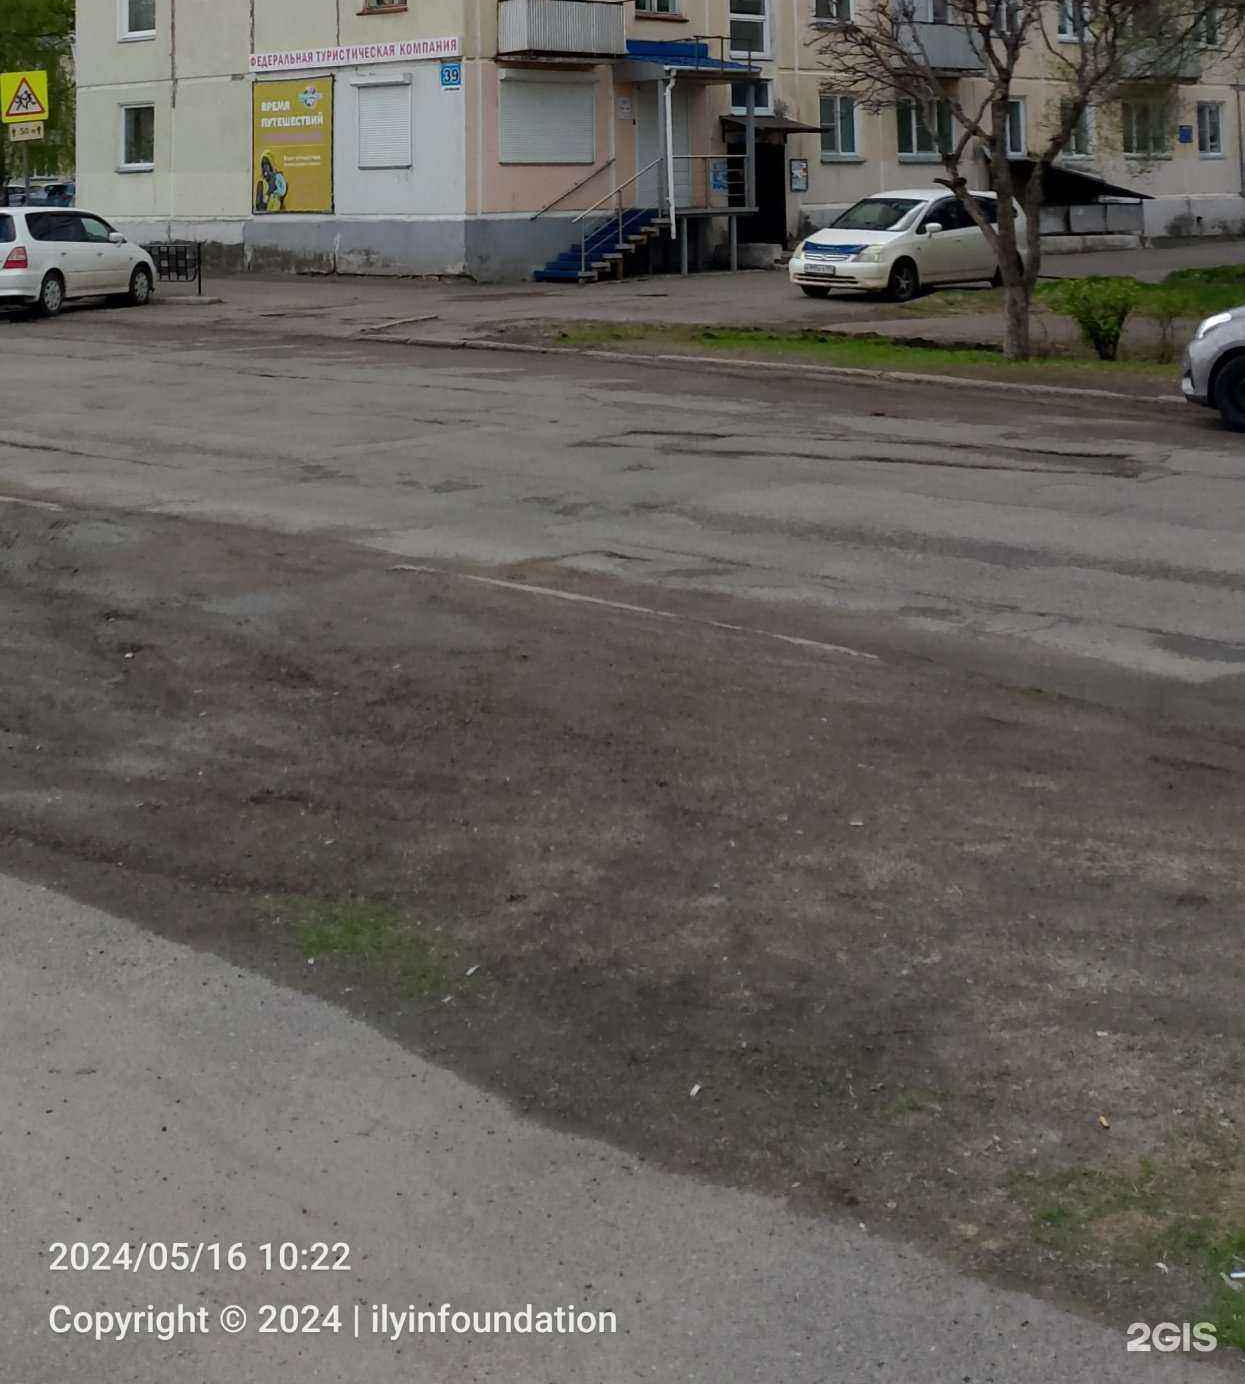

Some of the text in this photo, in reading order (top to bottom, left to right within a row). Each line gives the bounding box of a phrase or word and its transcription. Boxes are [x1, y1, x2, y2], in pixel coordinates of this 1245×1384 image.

[250, 38, 457, 67] ФЕДЕРАЛЬНАЯ ТУРИСТИЧЕСКАЯ КОМПАНИЯ
[443, 68, 459, 83] 39
[260, 100, 291, 113] ВРЕМЯ
[261, 112, 324, 129] ПУТЕШЕСТВИЙ
